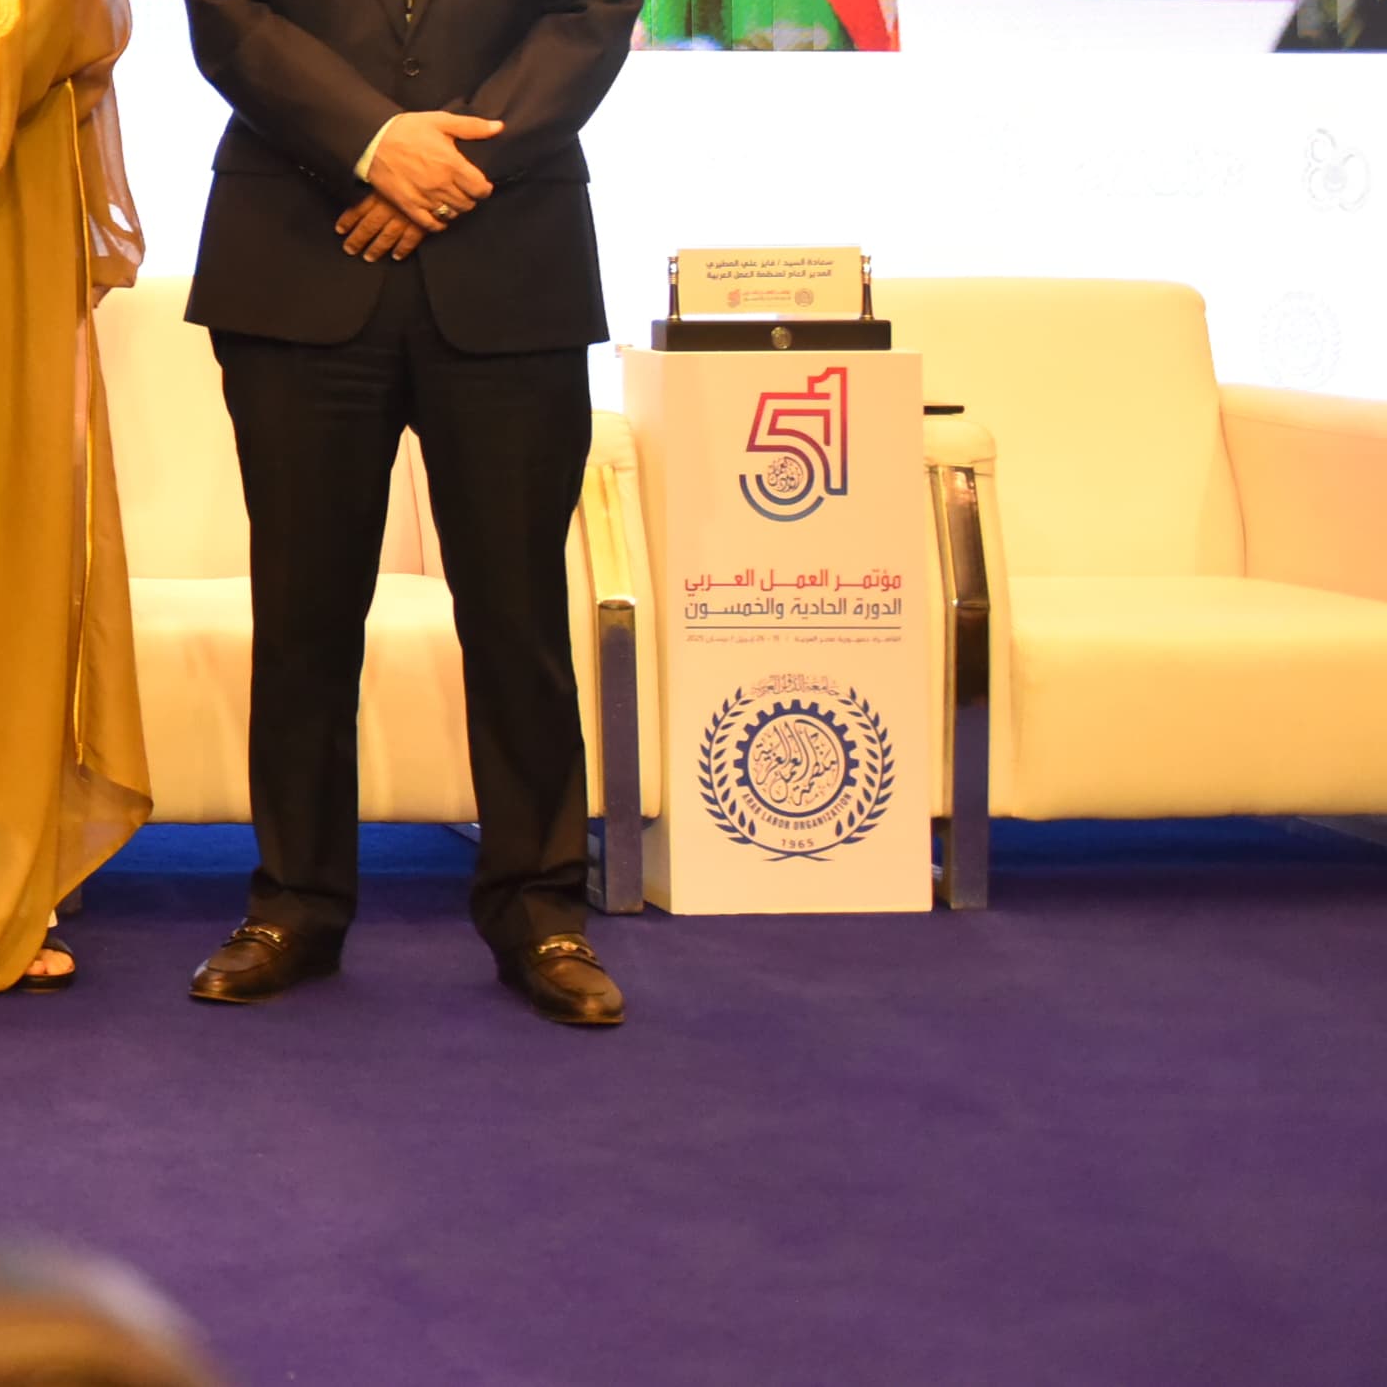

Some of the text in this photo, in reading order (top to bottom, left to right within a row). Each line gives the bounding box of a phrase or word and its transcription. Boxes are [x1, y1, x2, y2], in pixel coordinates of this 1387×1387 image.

[684, 568, 902, 597] مؤتمر العمل العربي
[684, 596, 902, 620] الدورة الحادية والخمسون
[741, 792, 853, 831] ARAB LABOR ORGANIZATION
[781, 838, 815, 849] 1965
